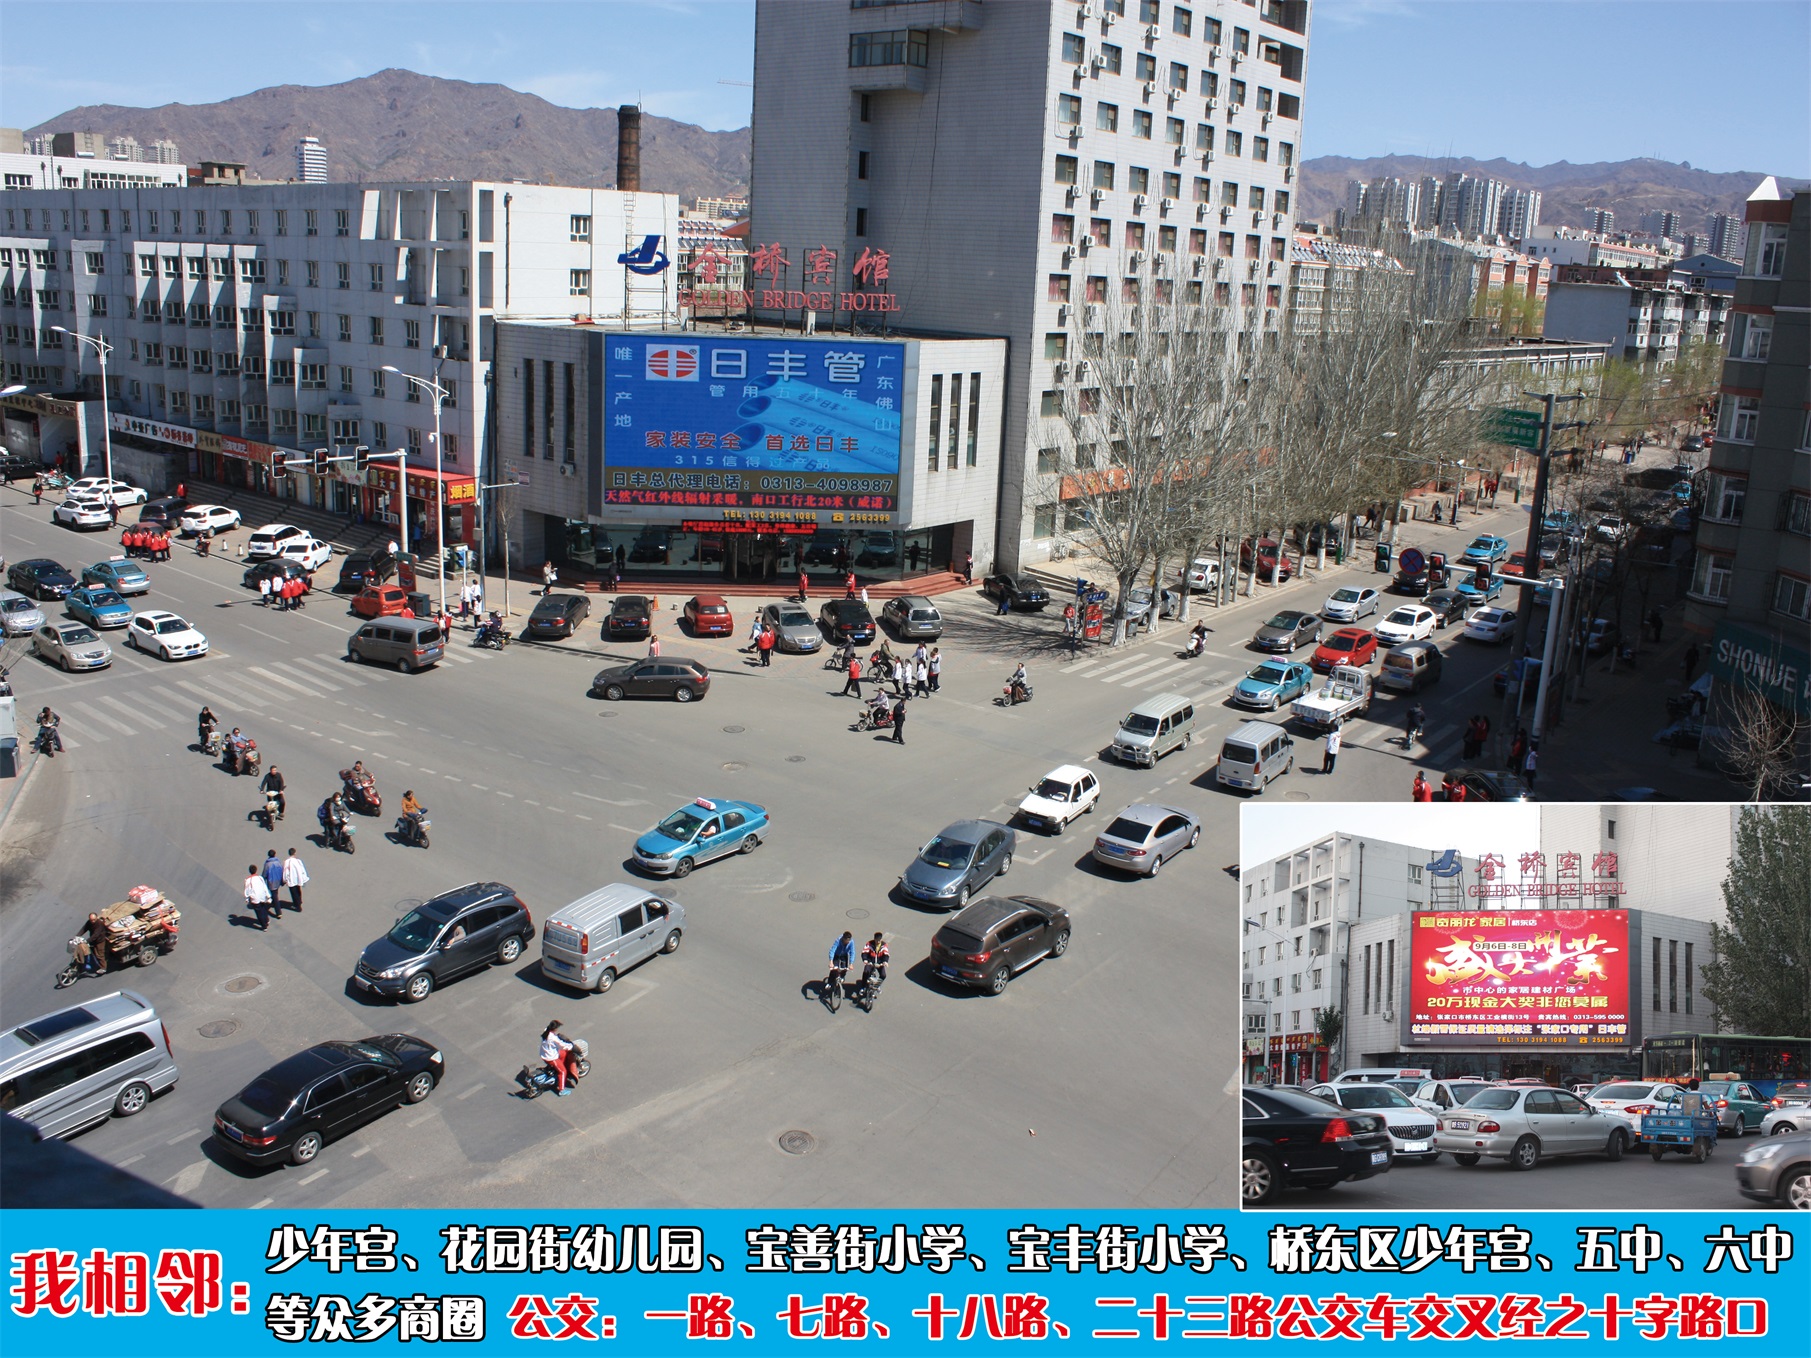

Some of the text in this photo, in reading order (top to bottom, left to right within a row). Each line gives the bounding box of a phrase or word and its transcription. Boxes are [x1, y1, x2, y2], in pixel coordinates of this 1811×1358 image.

[688, 242, 891, 289] 金桥宾馆
[678, 289, 900, 312] GOLDEN BRIDGE HOTEL
[710, 349, 866, 383] 日丰管
[614, 346, 632, 427] 唯一产地
[709, 384, 858, 400] 管用五十年
[875, 356, 896, 431] 广东佛山
[645, 431, 859, 453] 家装安全 首选日丰
[675, 454, 830, 469] 315信得过产品
[450, 483, 475, 499] 烟酒
[760, 476, 893, 492] 0313-4098987
[723, 510, 891, 522] TEL: 130 3194 1088 2563399
[1474, 850, 1619, 884] 金桥宾馆
[1468, 882, 1627, 897] GOLDEN BRIDGE HOTEL
[1475, 942, 1527, 950] 9月6日-8日
[1462, 986, 1576, 994] 市中心的家居建材广场
[1427, 996, 1608, 1008] 20万现金大奖非您莫属
